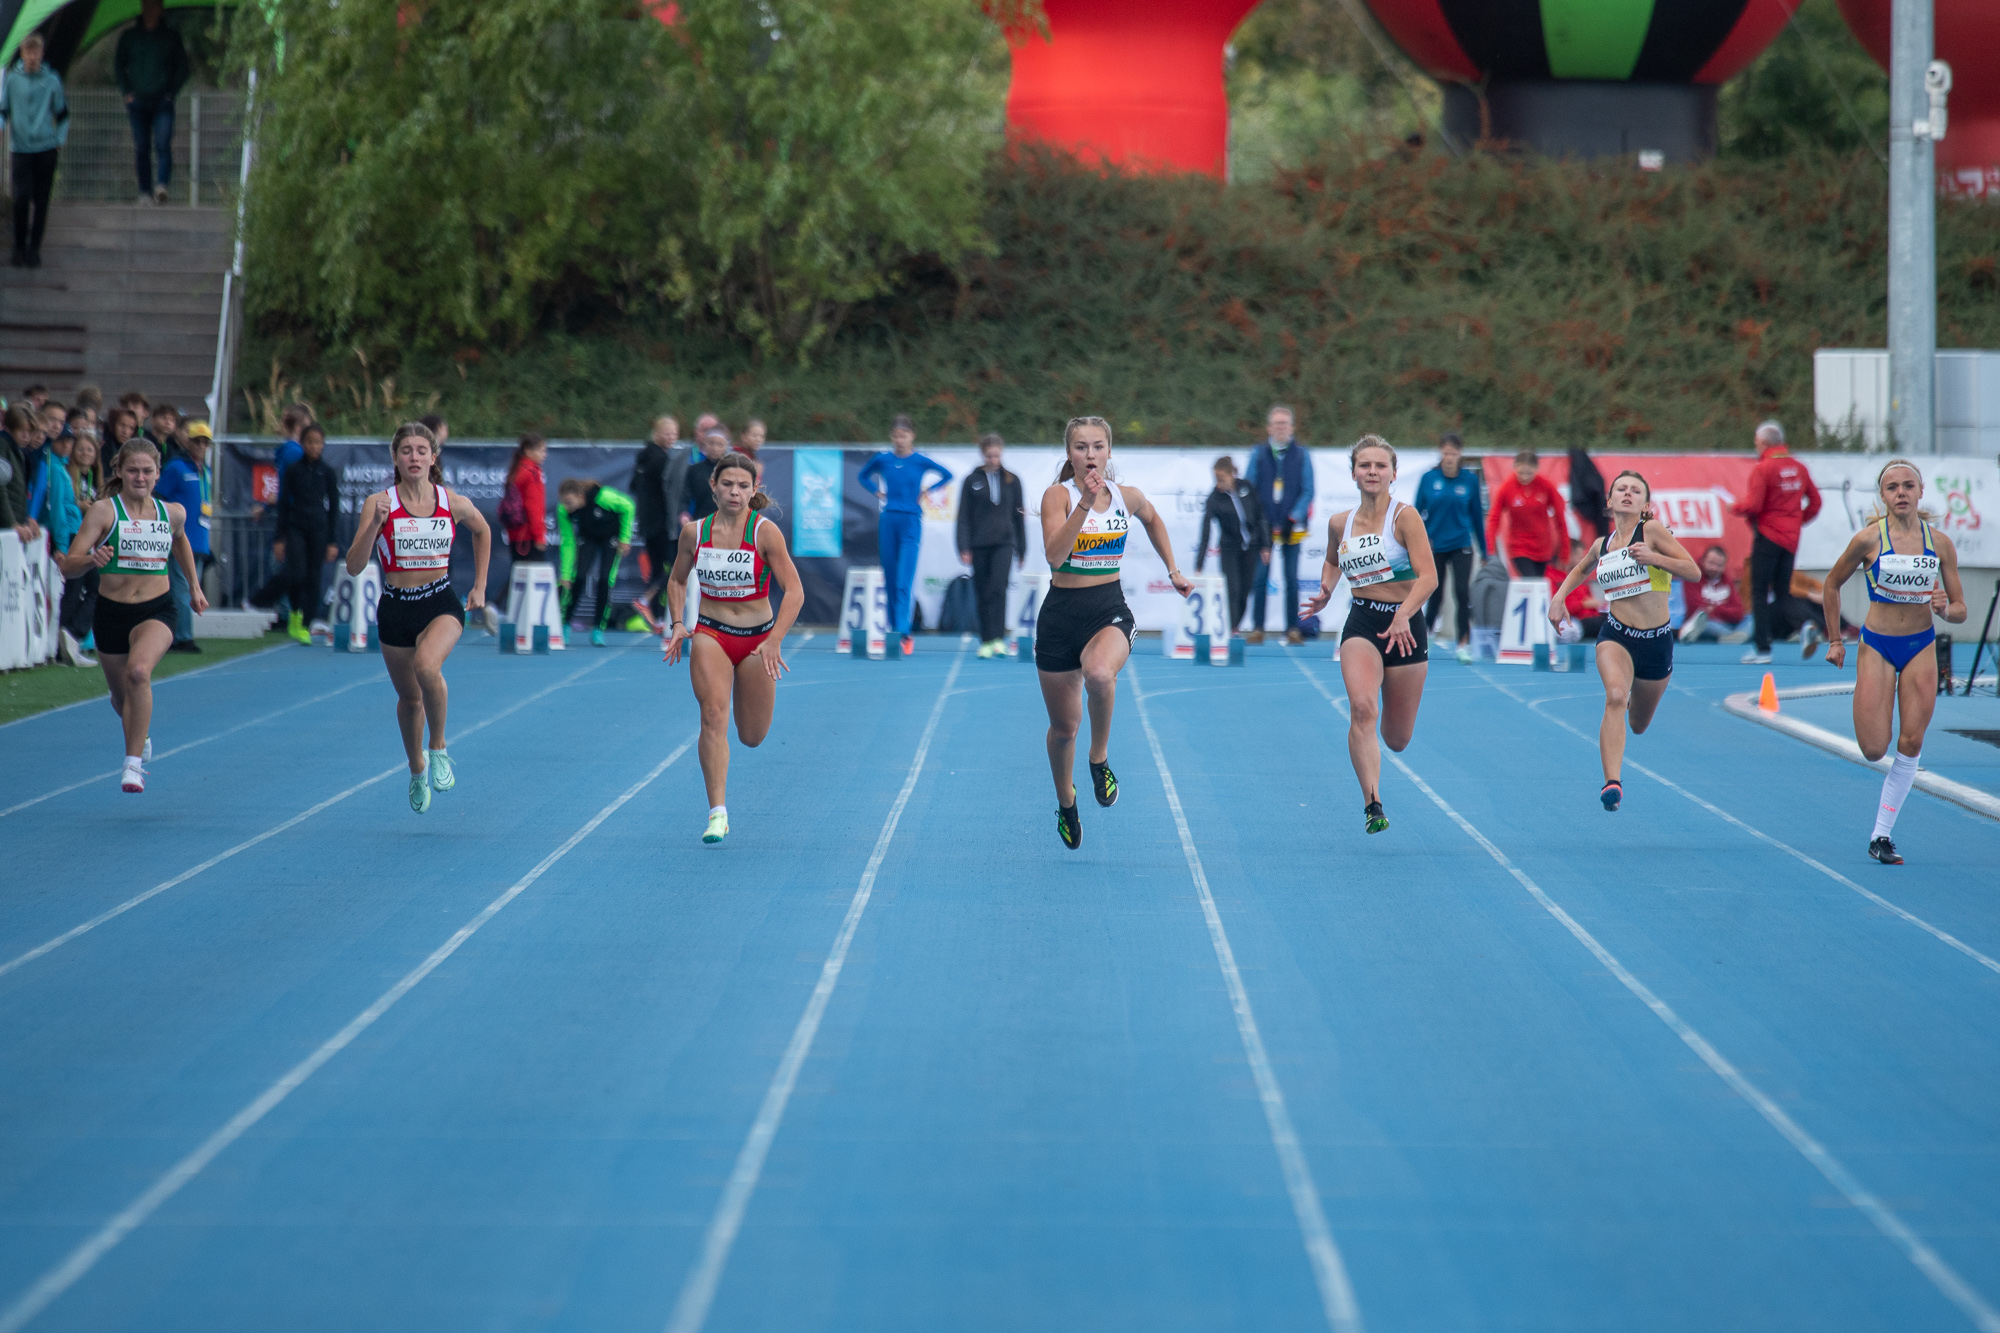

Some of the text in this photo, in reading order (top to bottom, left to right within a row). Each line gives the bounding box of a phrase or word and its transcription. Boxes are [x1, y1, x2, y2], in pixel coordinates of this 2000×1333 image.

[457, 465, 509, 485] POLSK
[1651, 500, 1714, 530] RLEN
[150, 522, 169, 534] 148
[430, 520, 446, 531] 79
[1106, 519, 1128, 531] 123
[121, 539, 169, 553] OSTROWSKA
[397, 538, 449, 550] TOPCZEWSKA
[1359, 535, 1380, 549] 215
[727, 552, 750, 563] 602
[1339, 552, 1385, 572] MATECKA
[1913, 557, 1936, 569] 558
[698, 569, 752, 581] PIASECKA
[1598, 564, 1646, 585] KOWALCZYK
[1885, 573, 1930, 586] ZAWÓŁ
[336, 580, 353, 623] 8
[707, 589, 727, 597] LUBLIN
[1612, 586, 1642, 599] LUBLIN 2022
[1885, 592, 1907, 601] LUBLIN
[364, 580, 377, 624] 8
[514, 582, 526, 624] 7
[534, 582, 551, 626] 7
[848, 587, 865, 630] 5
[873, 587, 888, 633] 5
[1018, 589, 1036, 637] 4
[1185, 592, 1203, 640] 3
[1213, 593, 1224, 637] 3
[1512, 598, 1528, 646] 1
[1625, 628, 1656, 639] NIKE
[1656, 623, 1671, 637] PR
